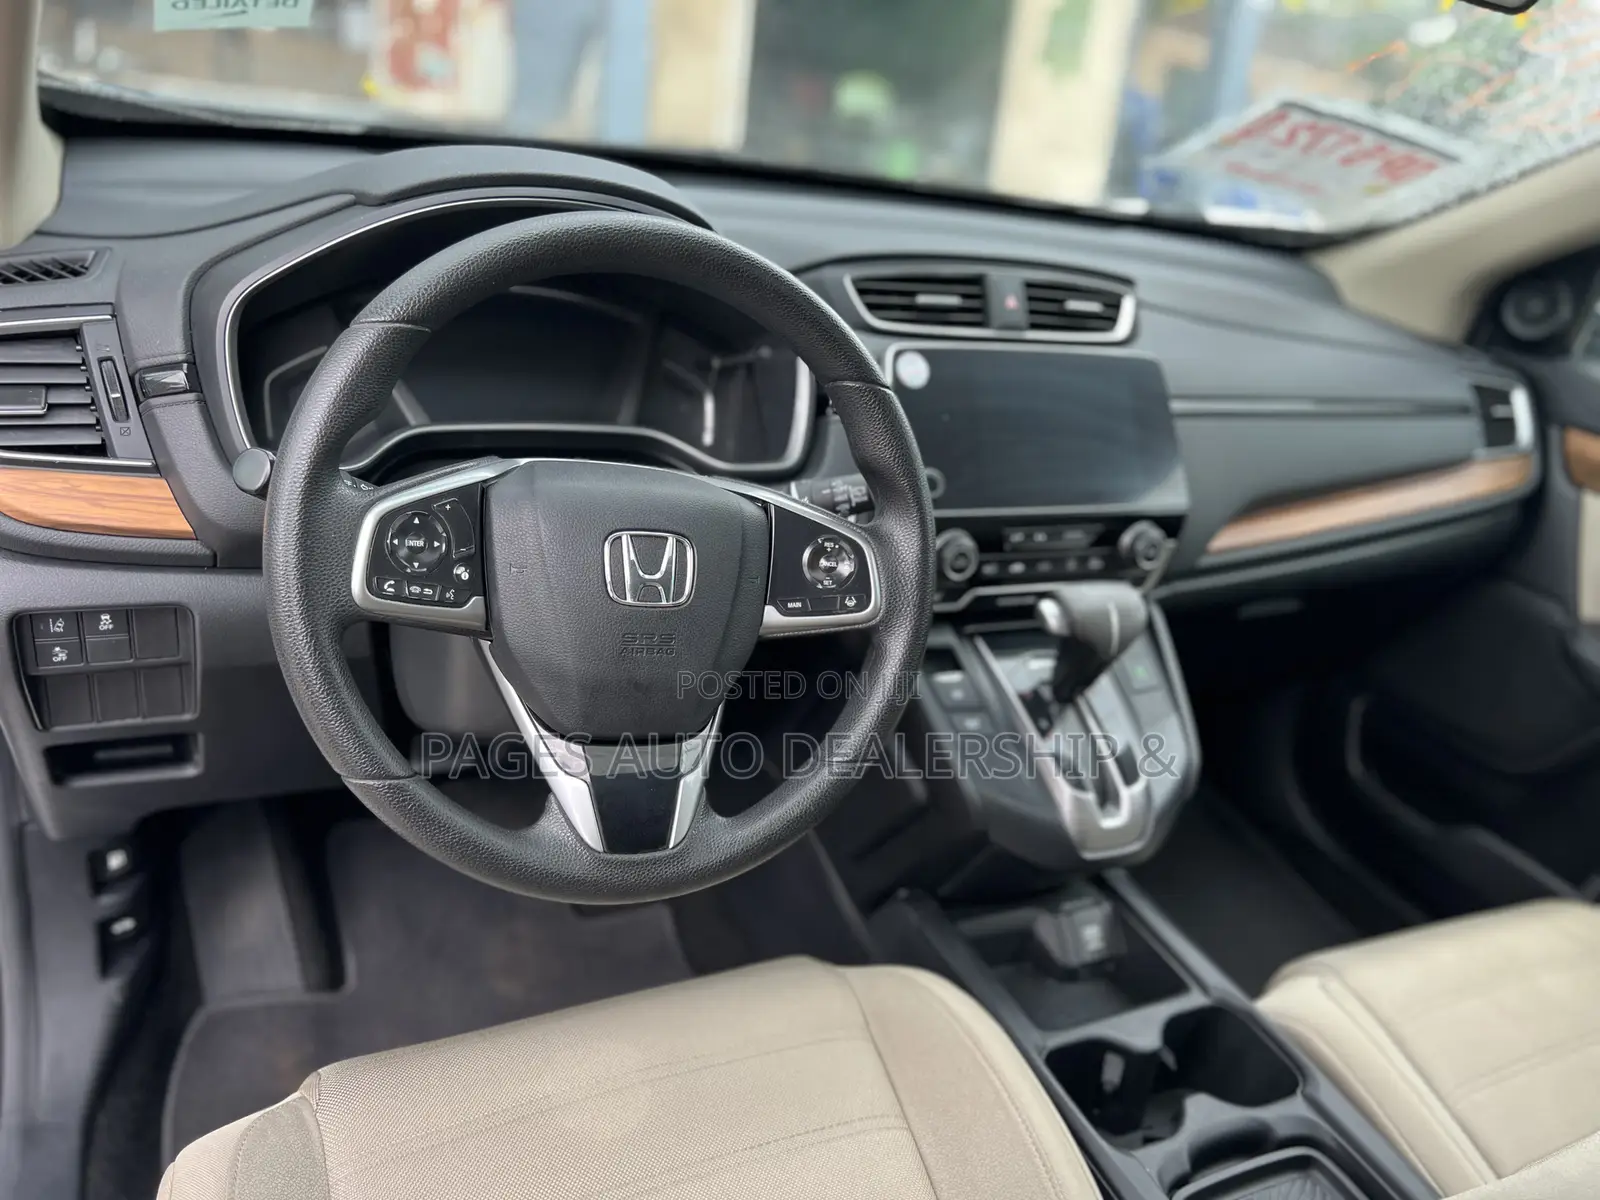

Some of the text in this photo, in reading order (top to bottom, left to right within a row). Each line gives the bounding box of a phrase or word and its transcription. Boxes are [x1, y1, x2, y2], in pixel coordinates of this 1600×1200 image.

[405, 538, 425, 547] ENTER
[819, 560, 838, 568] CANCEL
[98, 623, 114, 631] OFF
[620, 633, 676, 645] SRS
[620, 646, 676, 657] AIRBAG
